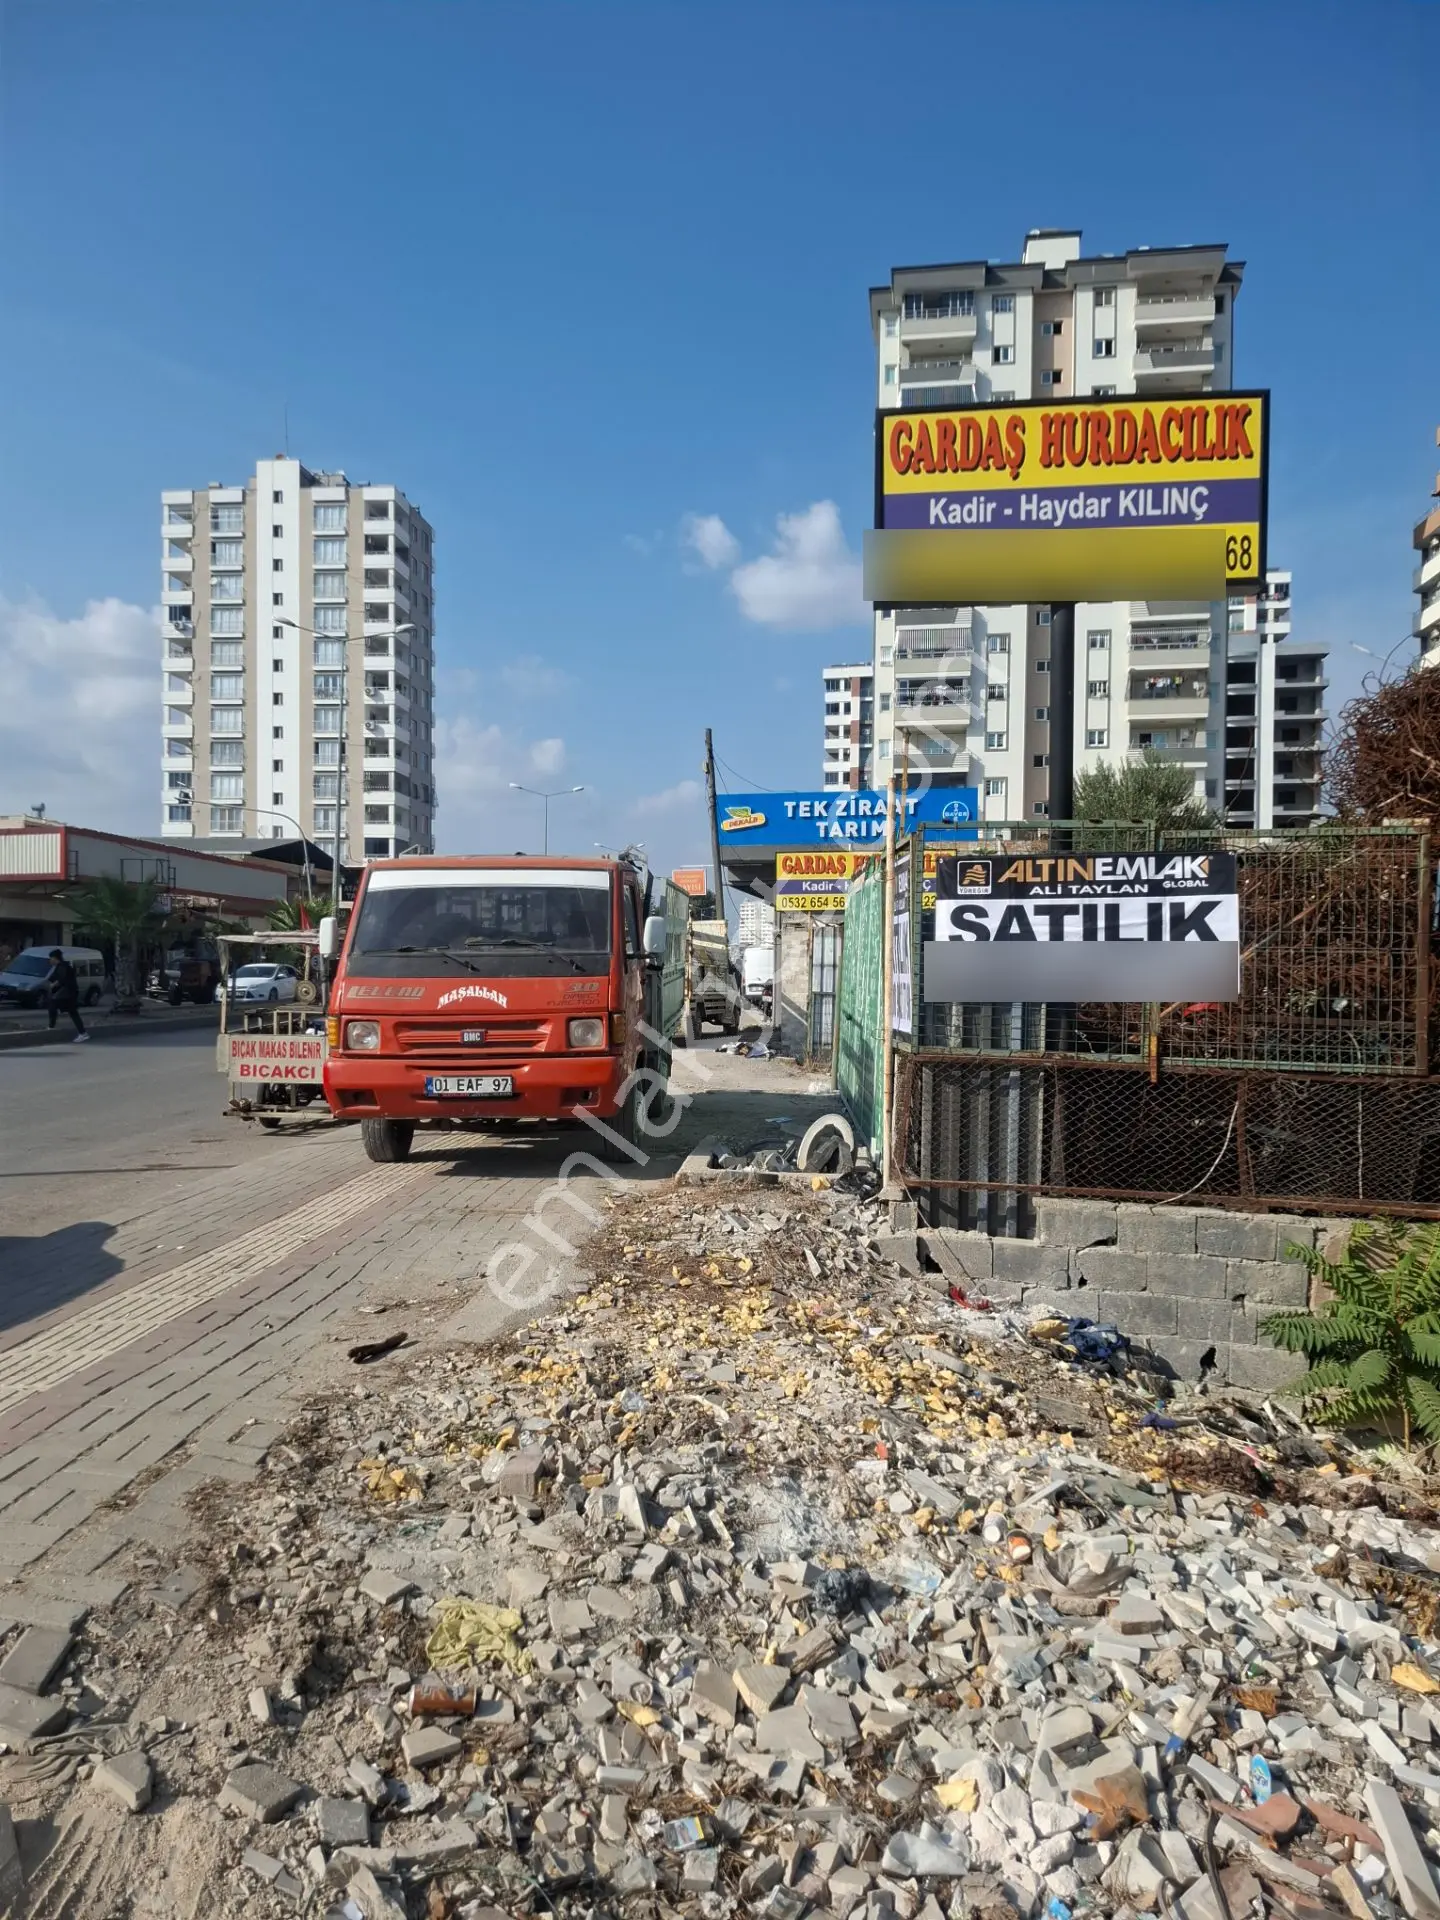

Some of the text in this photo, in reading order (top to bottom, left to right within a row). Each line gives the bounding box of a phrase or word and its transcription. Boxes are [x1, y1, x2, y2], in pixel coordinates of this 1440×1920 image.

[890, 403, 1254, 480] GARDAŞ HURDACILIK
[929, 497, 996, 525] Kadir
[1020, 493, 1112, 527] Haydar
[1118, 486, 1209, 520] KILINÇ
[1226, 535, 1252, 571] 68
[784, 795, 920, 818] TEK ZİRAAT
[816, 821, 889, 838] TARIM
[782, 855, 847, 877] GARDAŞ
[998, 855, 1209, 883] ALTINEMLAK
[802, 881, 834, 891] Kadir
[1029, 883, 1149, 896] ALİ TAYLAN
[1162, 879, 1209, 889] GLOBAL
[782, 896, 846, 908] 0532 654 56
[948, 900, 1224, 941] SATILIK
[437, 985, 508, 1010] MAŞALLAH
[463, 1032, 481, 1042] BMC
[258, 1040, 287, 1058] MAKAS
[434, 1079, 450, 1092] 01
[457, 1079, 483, 1092] EAF
[493, 1079, 509, 1092] 97
